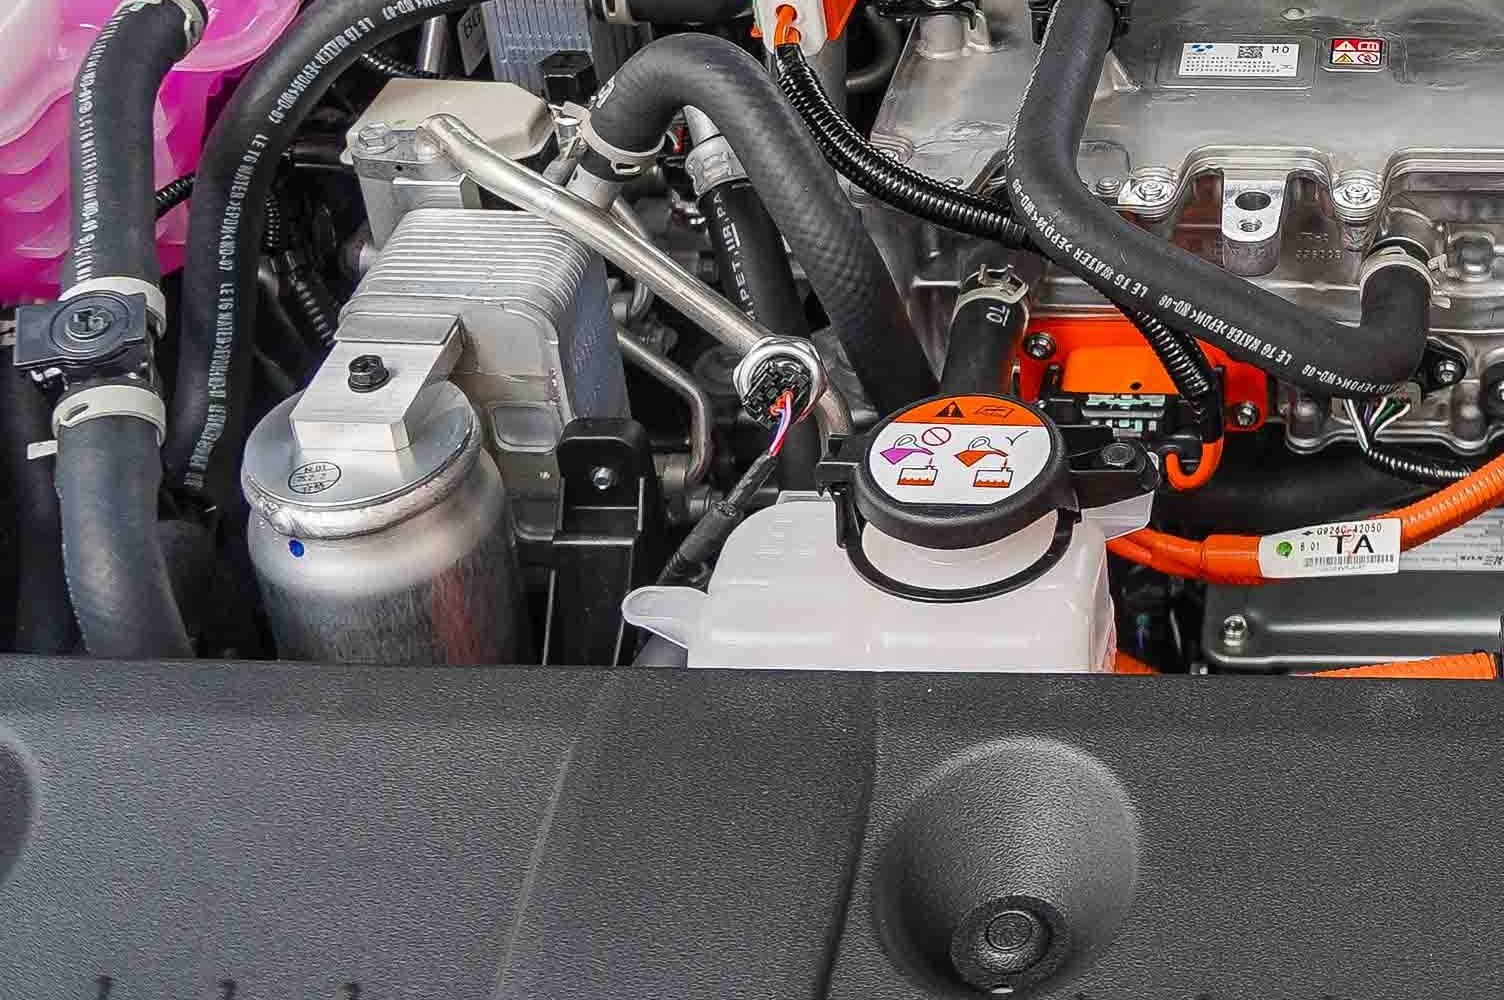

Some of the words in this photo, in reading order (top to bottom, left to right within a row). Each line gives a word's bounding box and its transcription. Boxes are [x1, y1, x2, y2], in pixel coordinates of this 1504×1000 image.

[1072, 248, 1115, 281] WATER
[1226, 326, 1261, 353] WATER
[1329, 533, 1375, 555] TA
